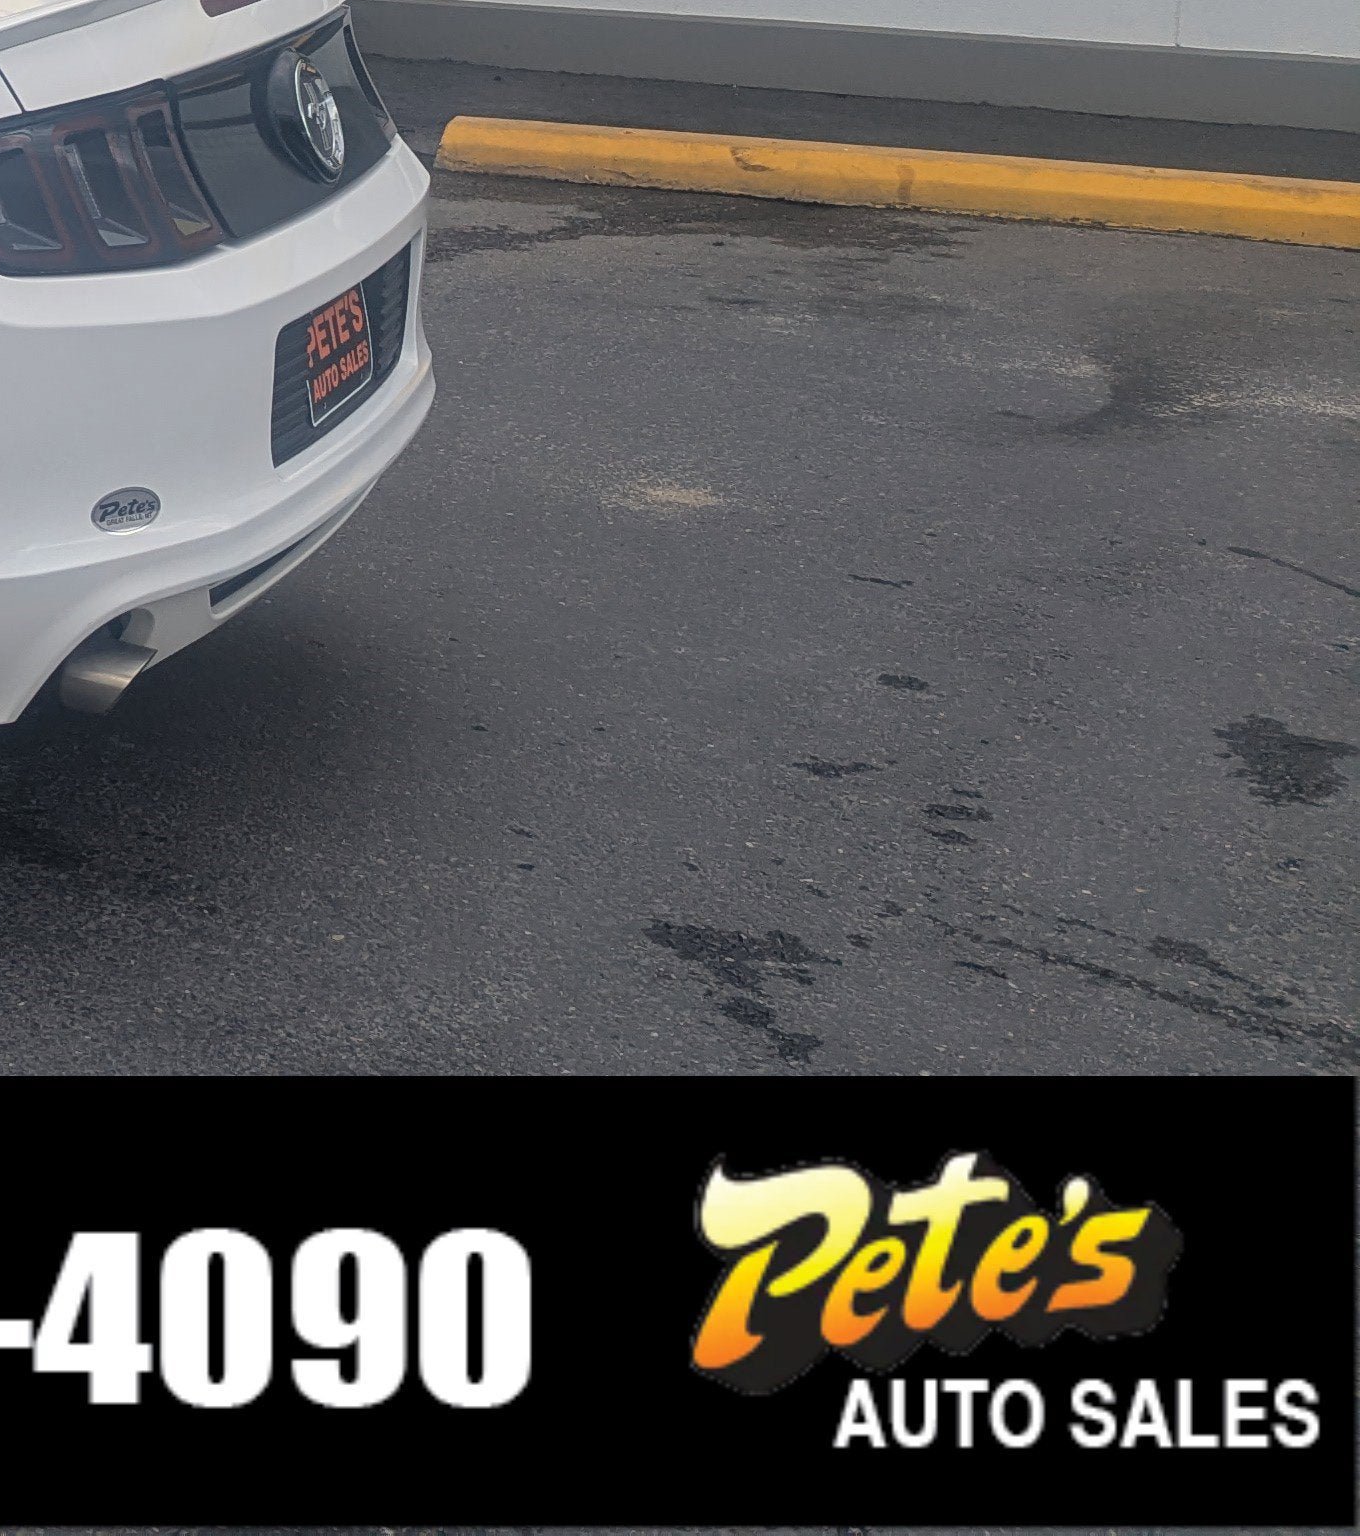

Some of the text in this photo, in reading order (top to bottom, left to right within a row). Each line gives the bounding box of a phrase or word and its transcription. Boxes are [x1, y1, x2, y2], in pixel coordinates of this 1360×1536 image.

[306, 289, 364, 369] PETE'S
[313, 339, 370, 404] AUTO SALES
[99, 498, 156, 523] Pete's
